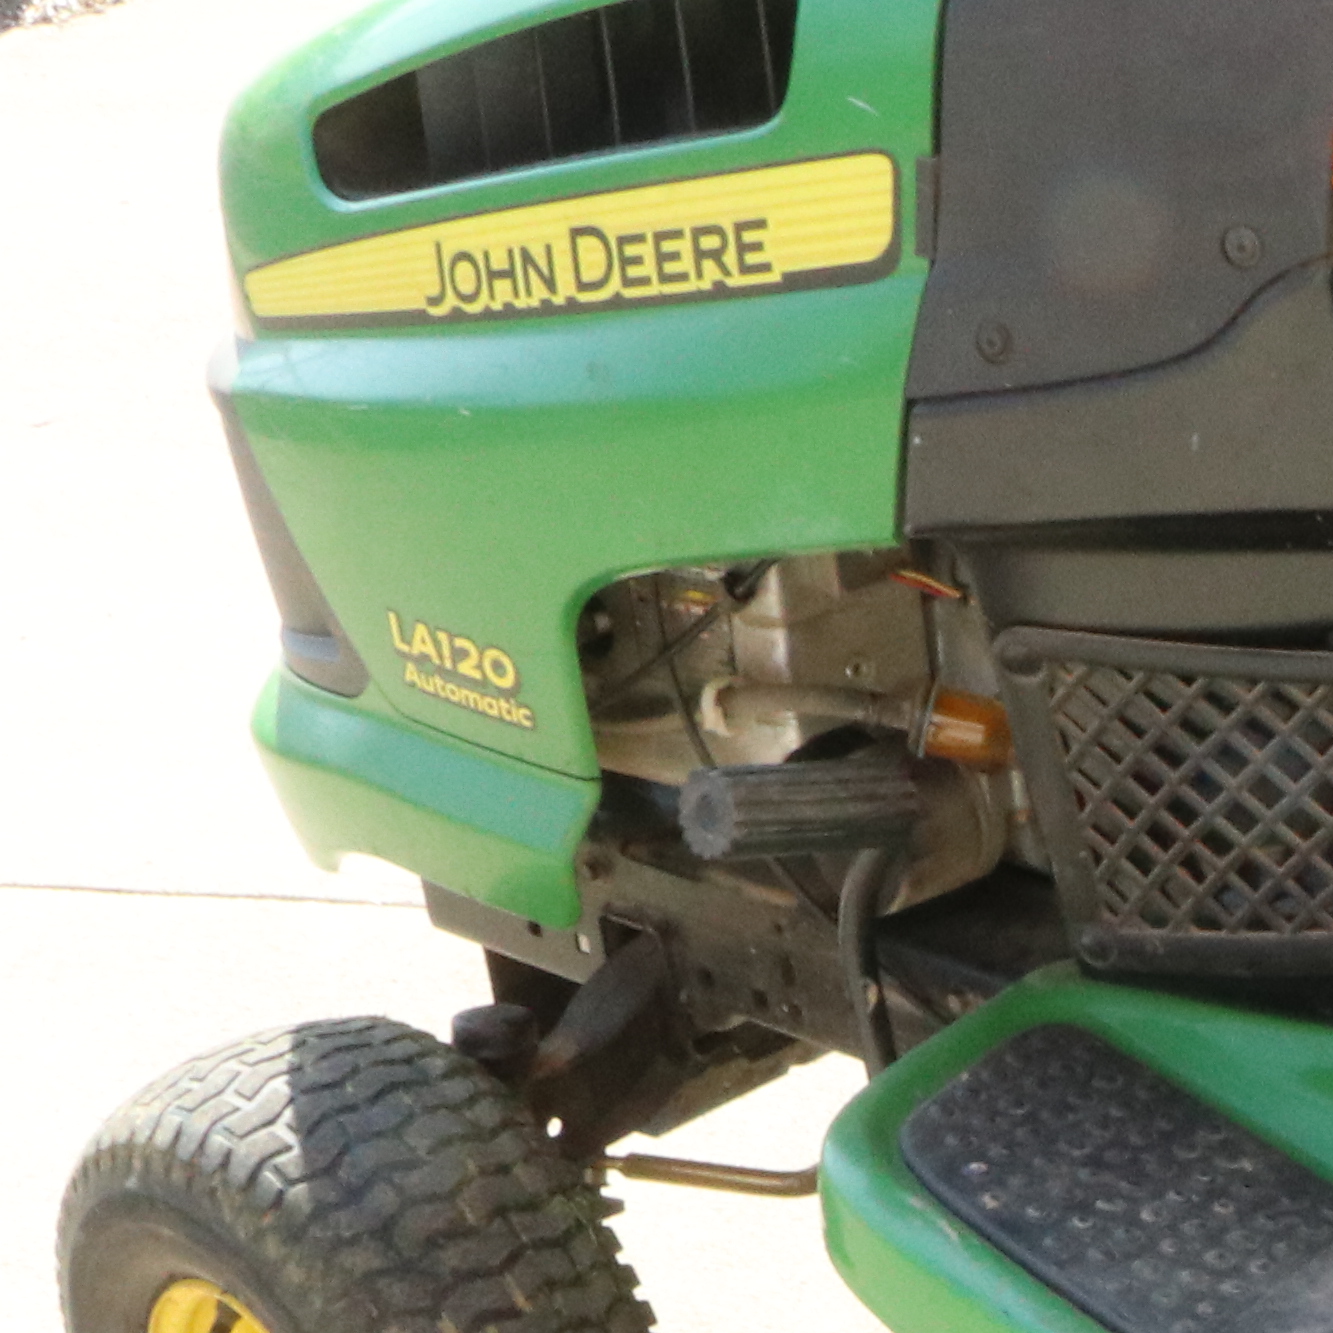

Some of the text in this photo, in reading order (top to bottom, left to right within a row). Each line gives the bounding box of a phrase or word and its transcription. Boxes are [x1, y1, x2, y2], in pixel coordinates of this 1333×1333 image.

[425, 218, 773, 307] JOHN DEERE
[387, 608, 518, 692] LA120
[404, 661, 535, 729] Automatic
